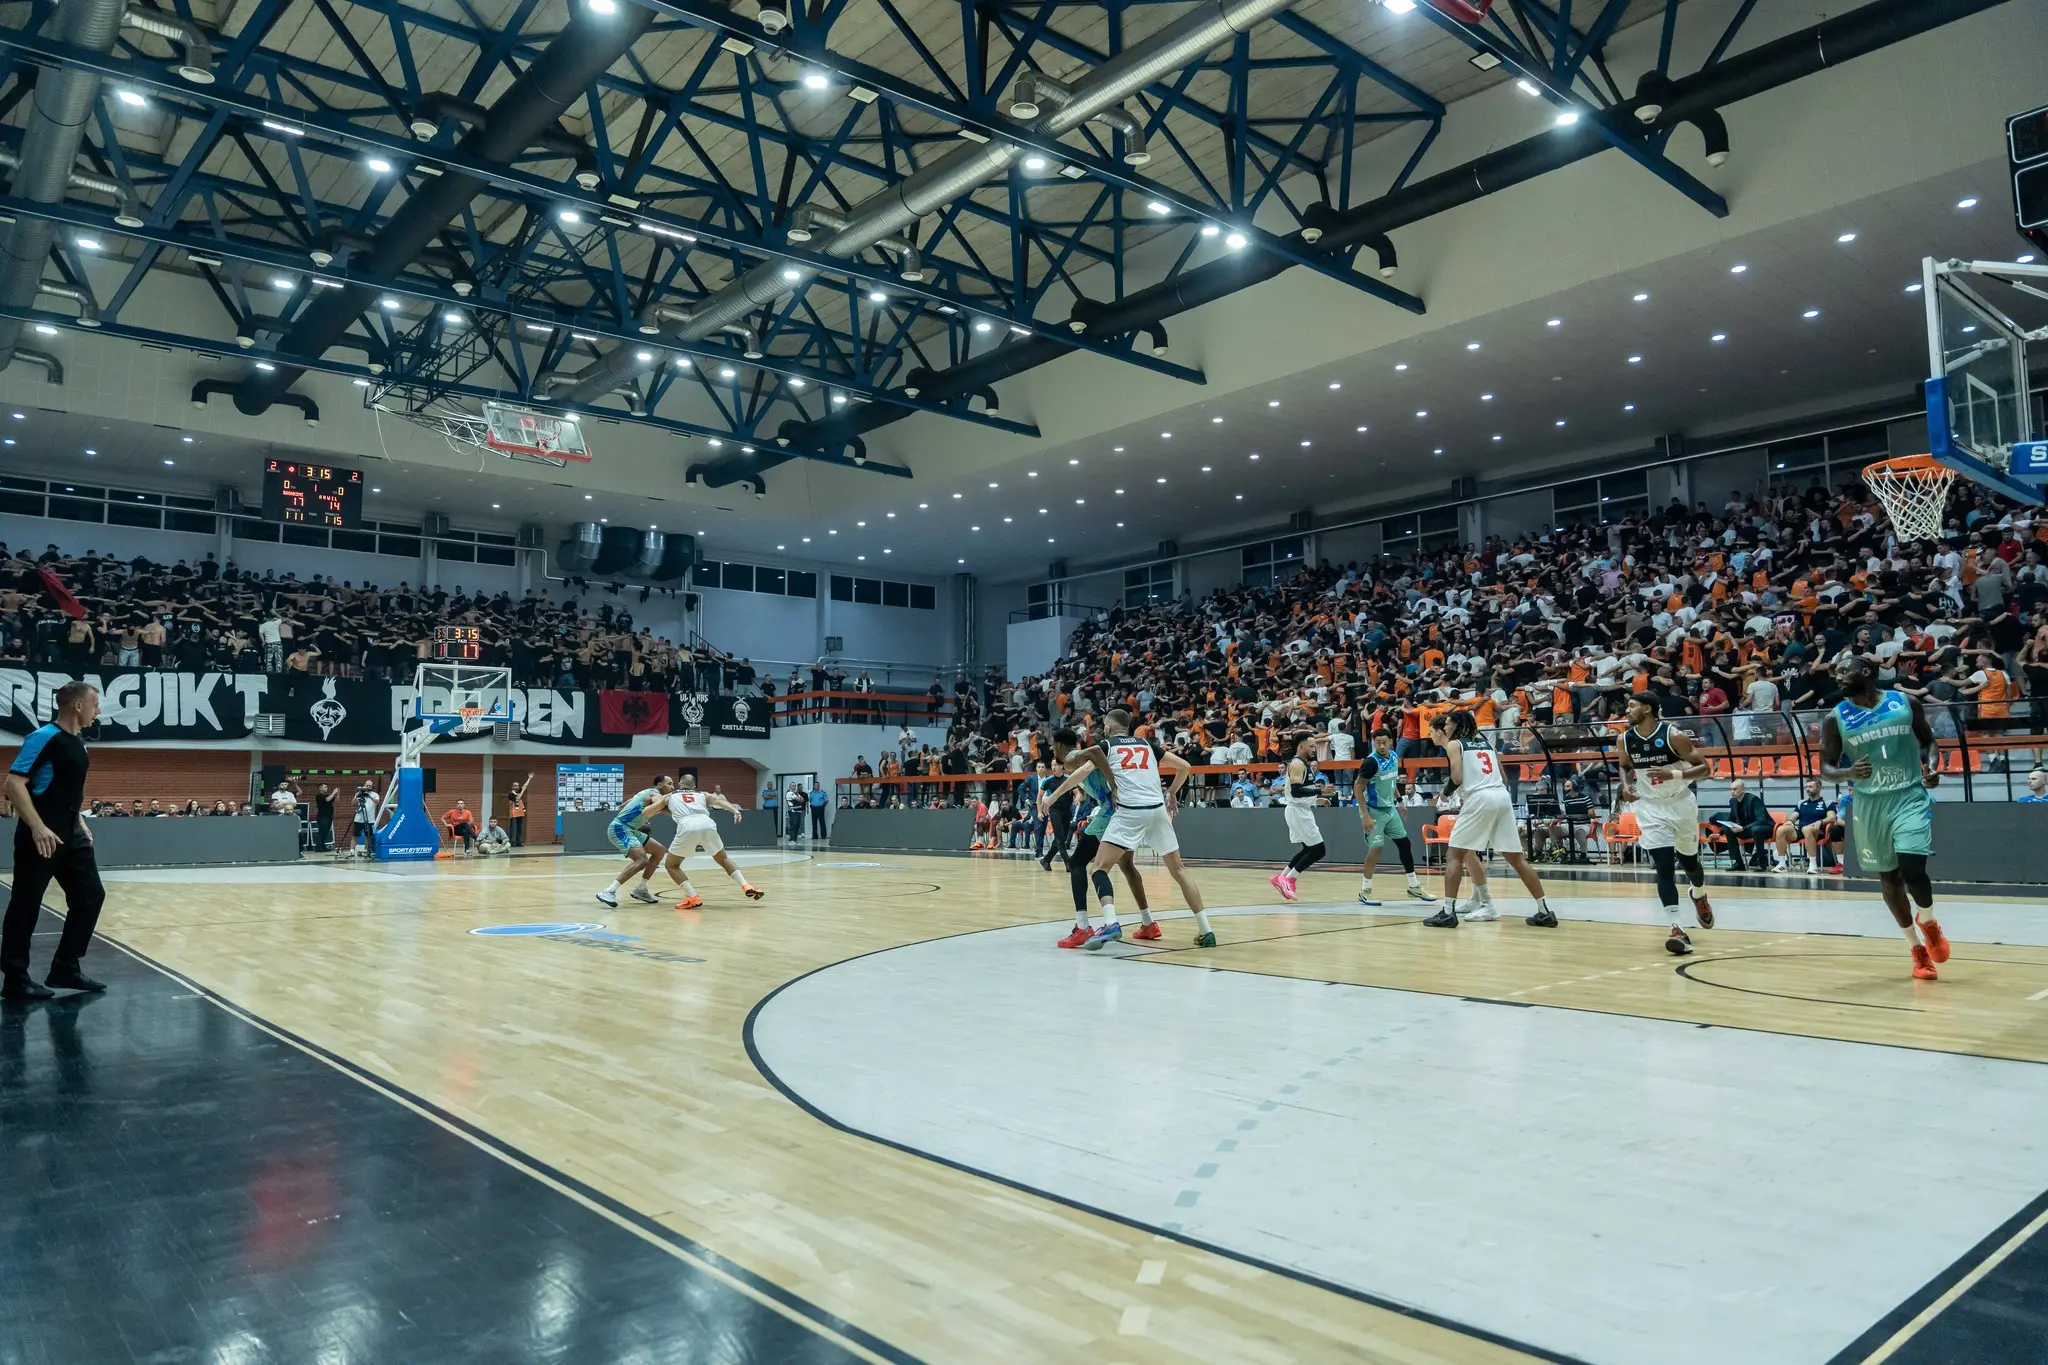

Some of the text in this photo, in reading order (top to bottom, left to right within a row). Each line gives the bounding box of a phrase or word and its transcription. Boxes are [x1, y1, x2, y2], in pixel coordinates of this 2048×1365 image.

[270, 461, 277, 470] 2
[306, 466, 331, 479] 3:15
[351, 472, 358, 481] 2
[283, 480, 290, 489] 0
[338, 487, 344, 496] 0
[293, 497, 304, 507] 17
[330, 502, 340, 511] 14
[286, 511, 304, 521] 1:11
[325, 516, 342, 526] 1:15
[455, 628, 478, 640] 3:15
[463, 644, 478, 658] 17
[1881, 744, 1888, 760] 1
[1116, 746, 1150, 770] 27
[1476, 751, 1493, 775] 3
[681, 793, 696, 804] 6
